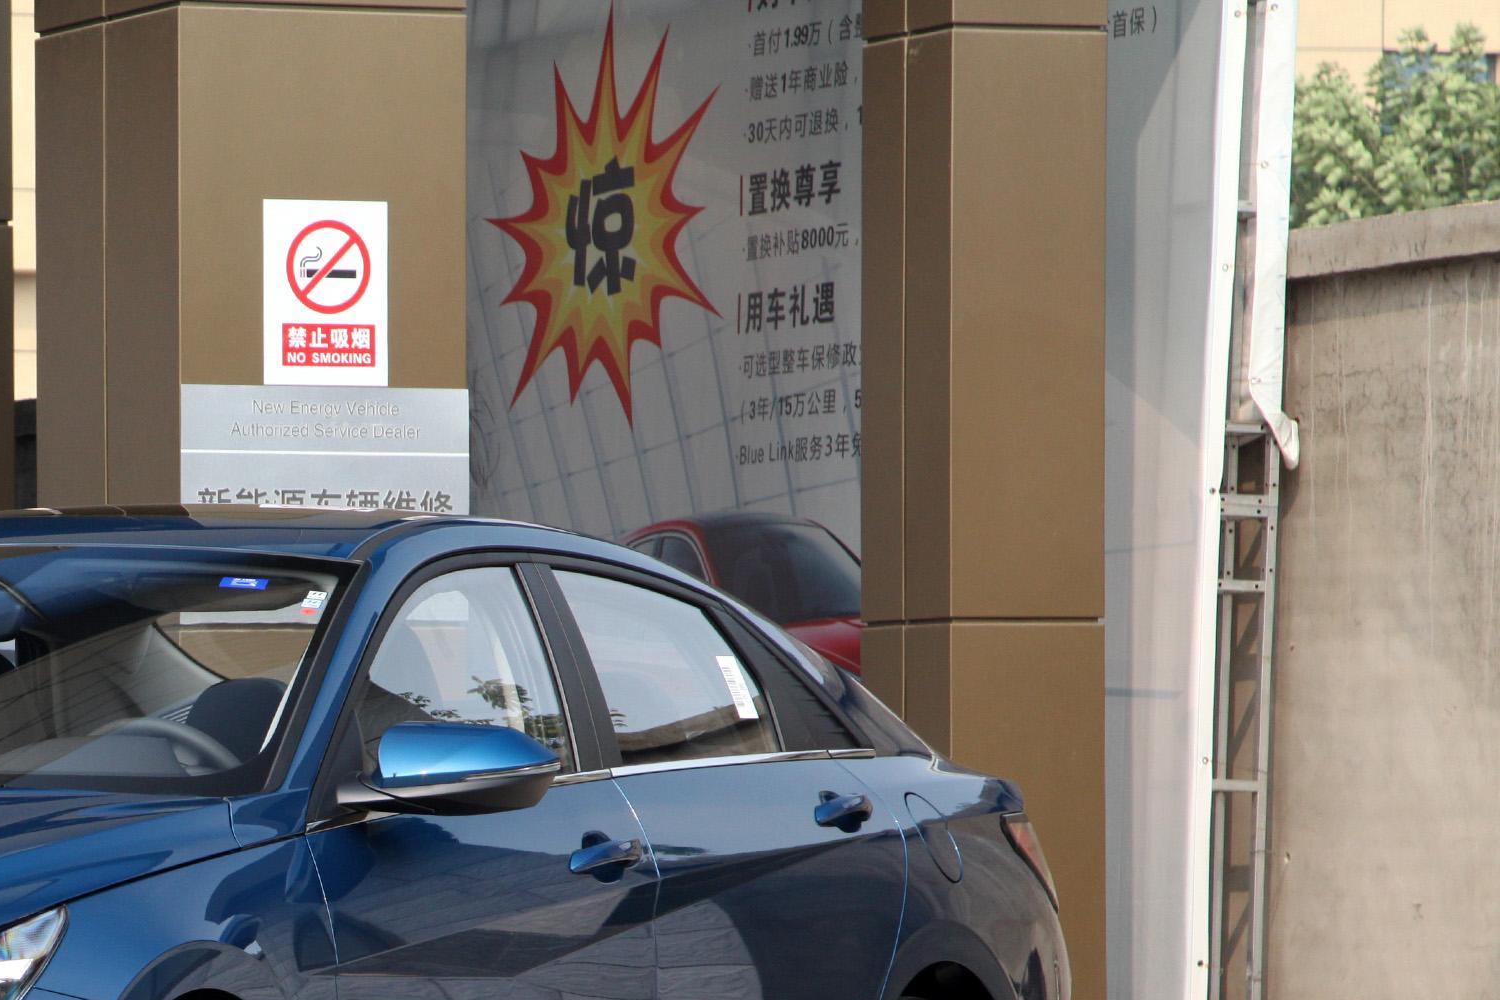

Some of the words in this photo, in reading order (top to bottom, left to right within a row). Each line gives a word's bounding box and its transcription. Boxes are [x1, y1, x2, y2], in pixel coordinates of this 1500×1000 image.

[748, 160, 842, 216] 置换尊享
[565, 156, 636, 296] 惊
[745, 281, 836, 335] 用车礼遇
[287, 326, 370, 349] 禁止吸烟
[287, 351, 306, 363] NO
[312, 352, 371, 364] SMOKING
[743, 340, 862, 379] 可选型整车保修政
[252, 400, 284, 415] New
[290, 401, 340, 418] Energy
[347, 401, 400, 416] Vehicle
[231, 422, 309, 438] Authorized
[314, 423, 368, 439] Service
[373, 424, 421, 440] Dealer
